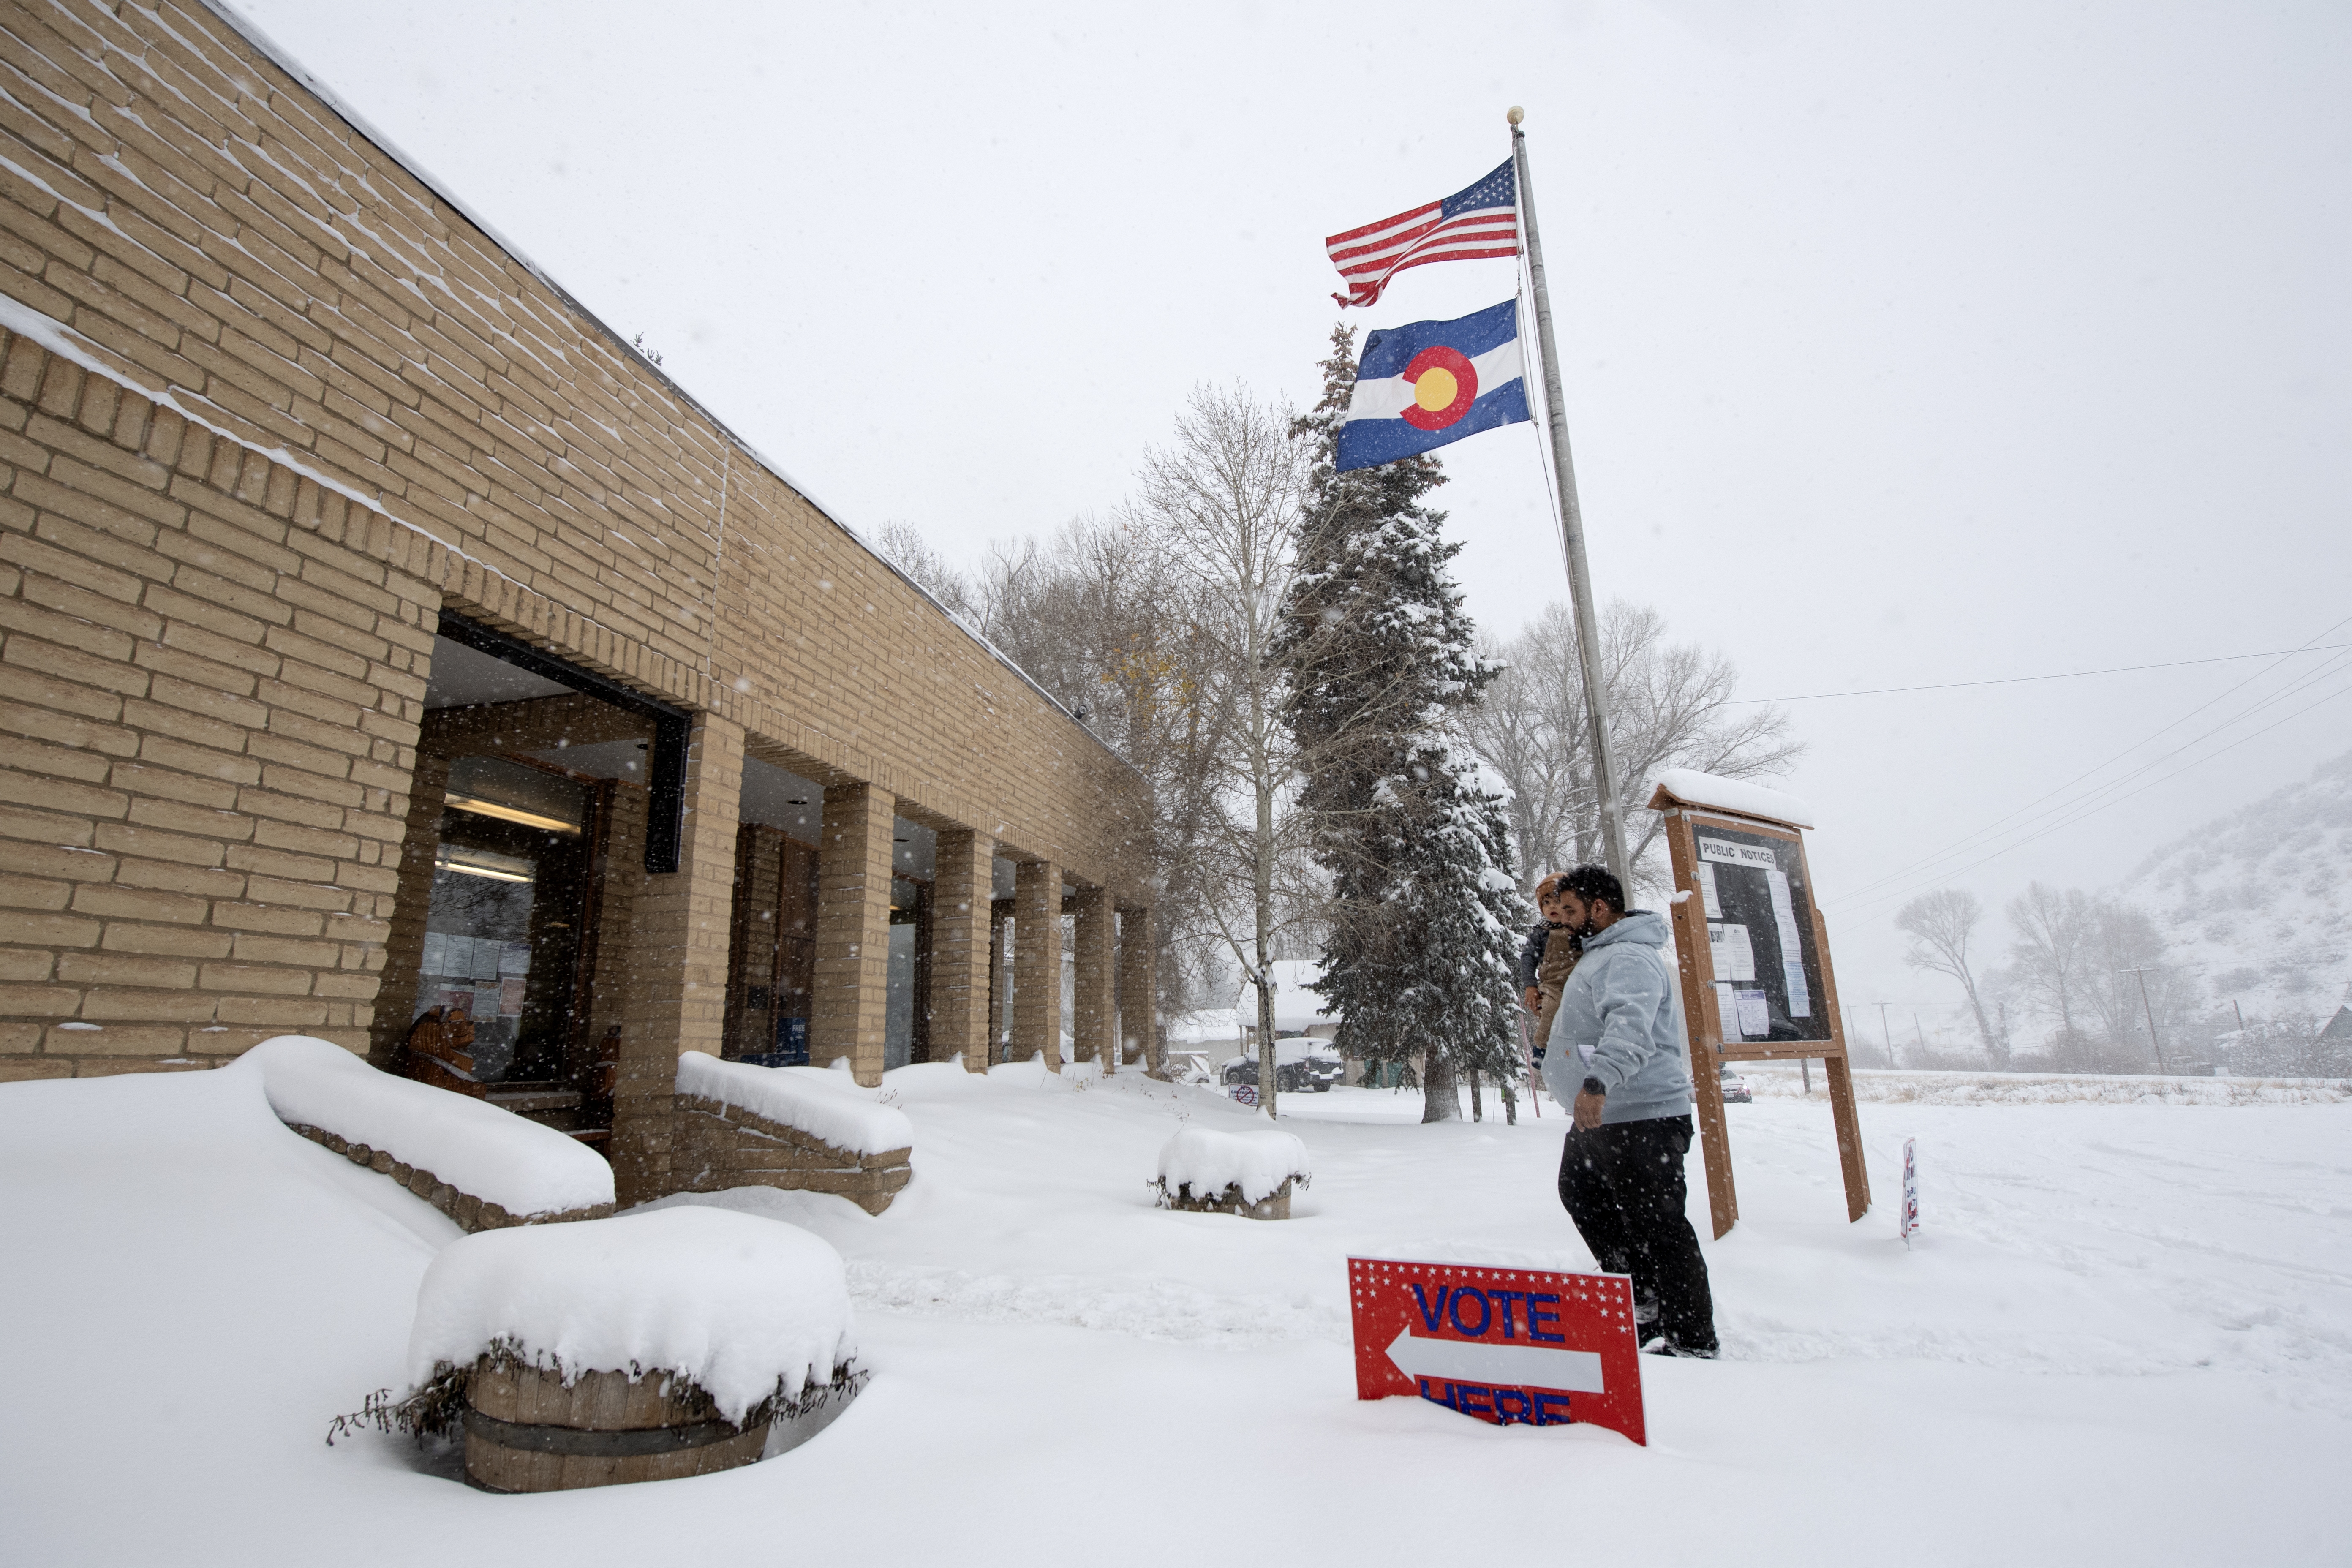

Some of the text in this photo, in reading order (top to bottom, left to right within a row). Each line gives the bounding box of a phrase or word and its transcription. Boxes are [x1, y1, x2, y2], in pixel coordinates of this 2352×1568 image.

[1703, 843, 1774, 864] PUBLIC NOTICES
[1412, 1283, 1565, 1343] VOTE
